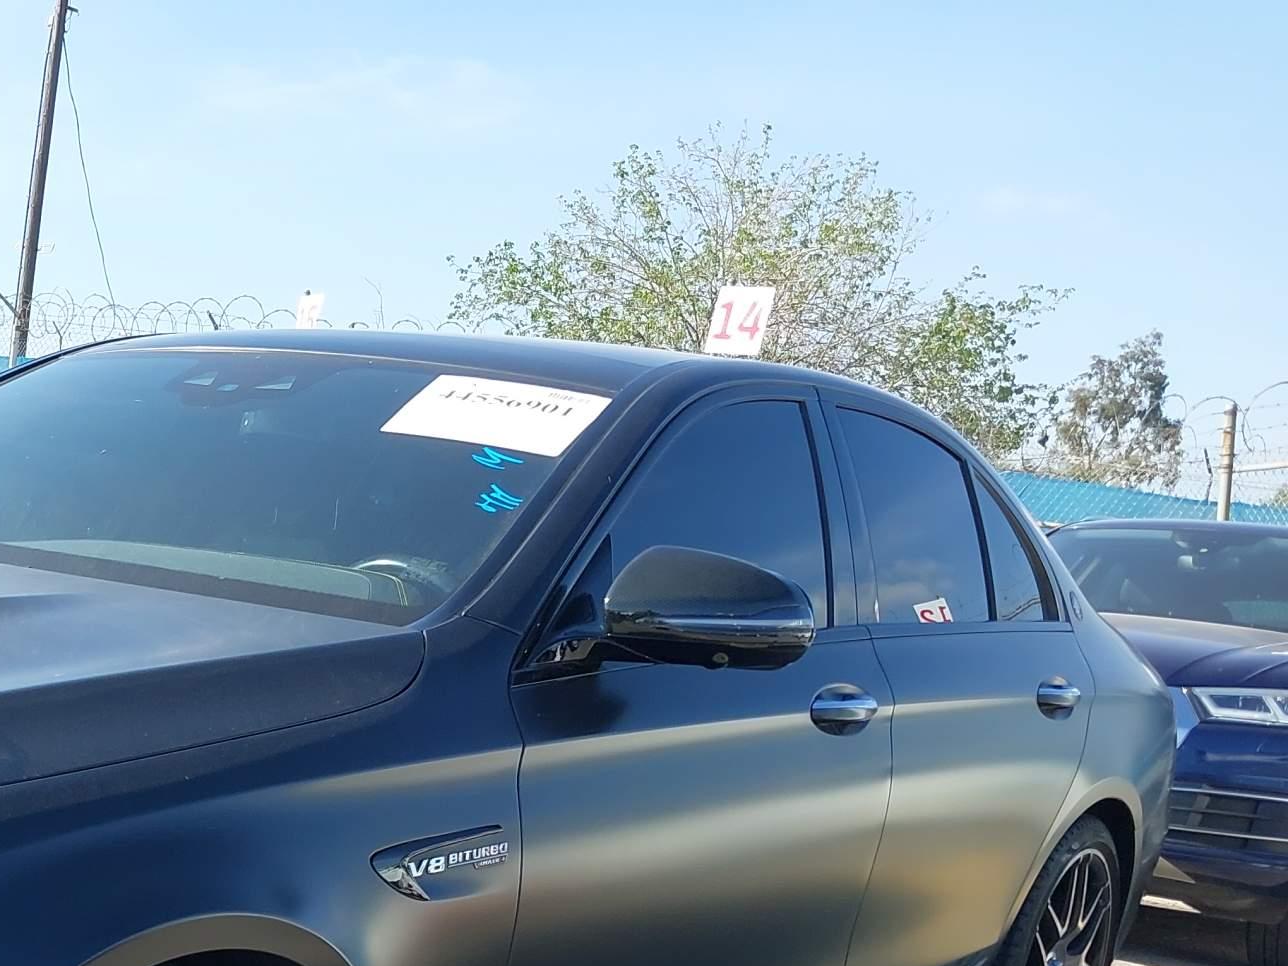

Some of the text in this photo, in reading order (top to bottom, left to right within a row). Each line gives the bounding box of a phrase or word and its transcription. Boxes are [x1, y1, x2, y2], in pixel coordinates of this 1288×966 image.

[713, 301, 761, 339] 14
[408, 843, 508, 878] V8 BITURBO
